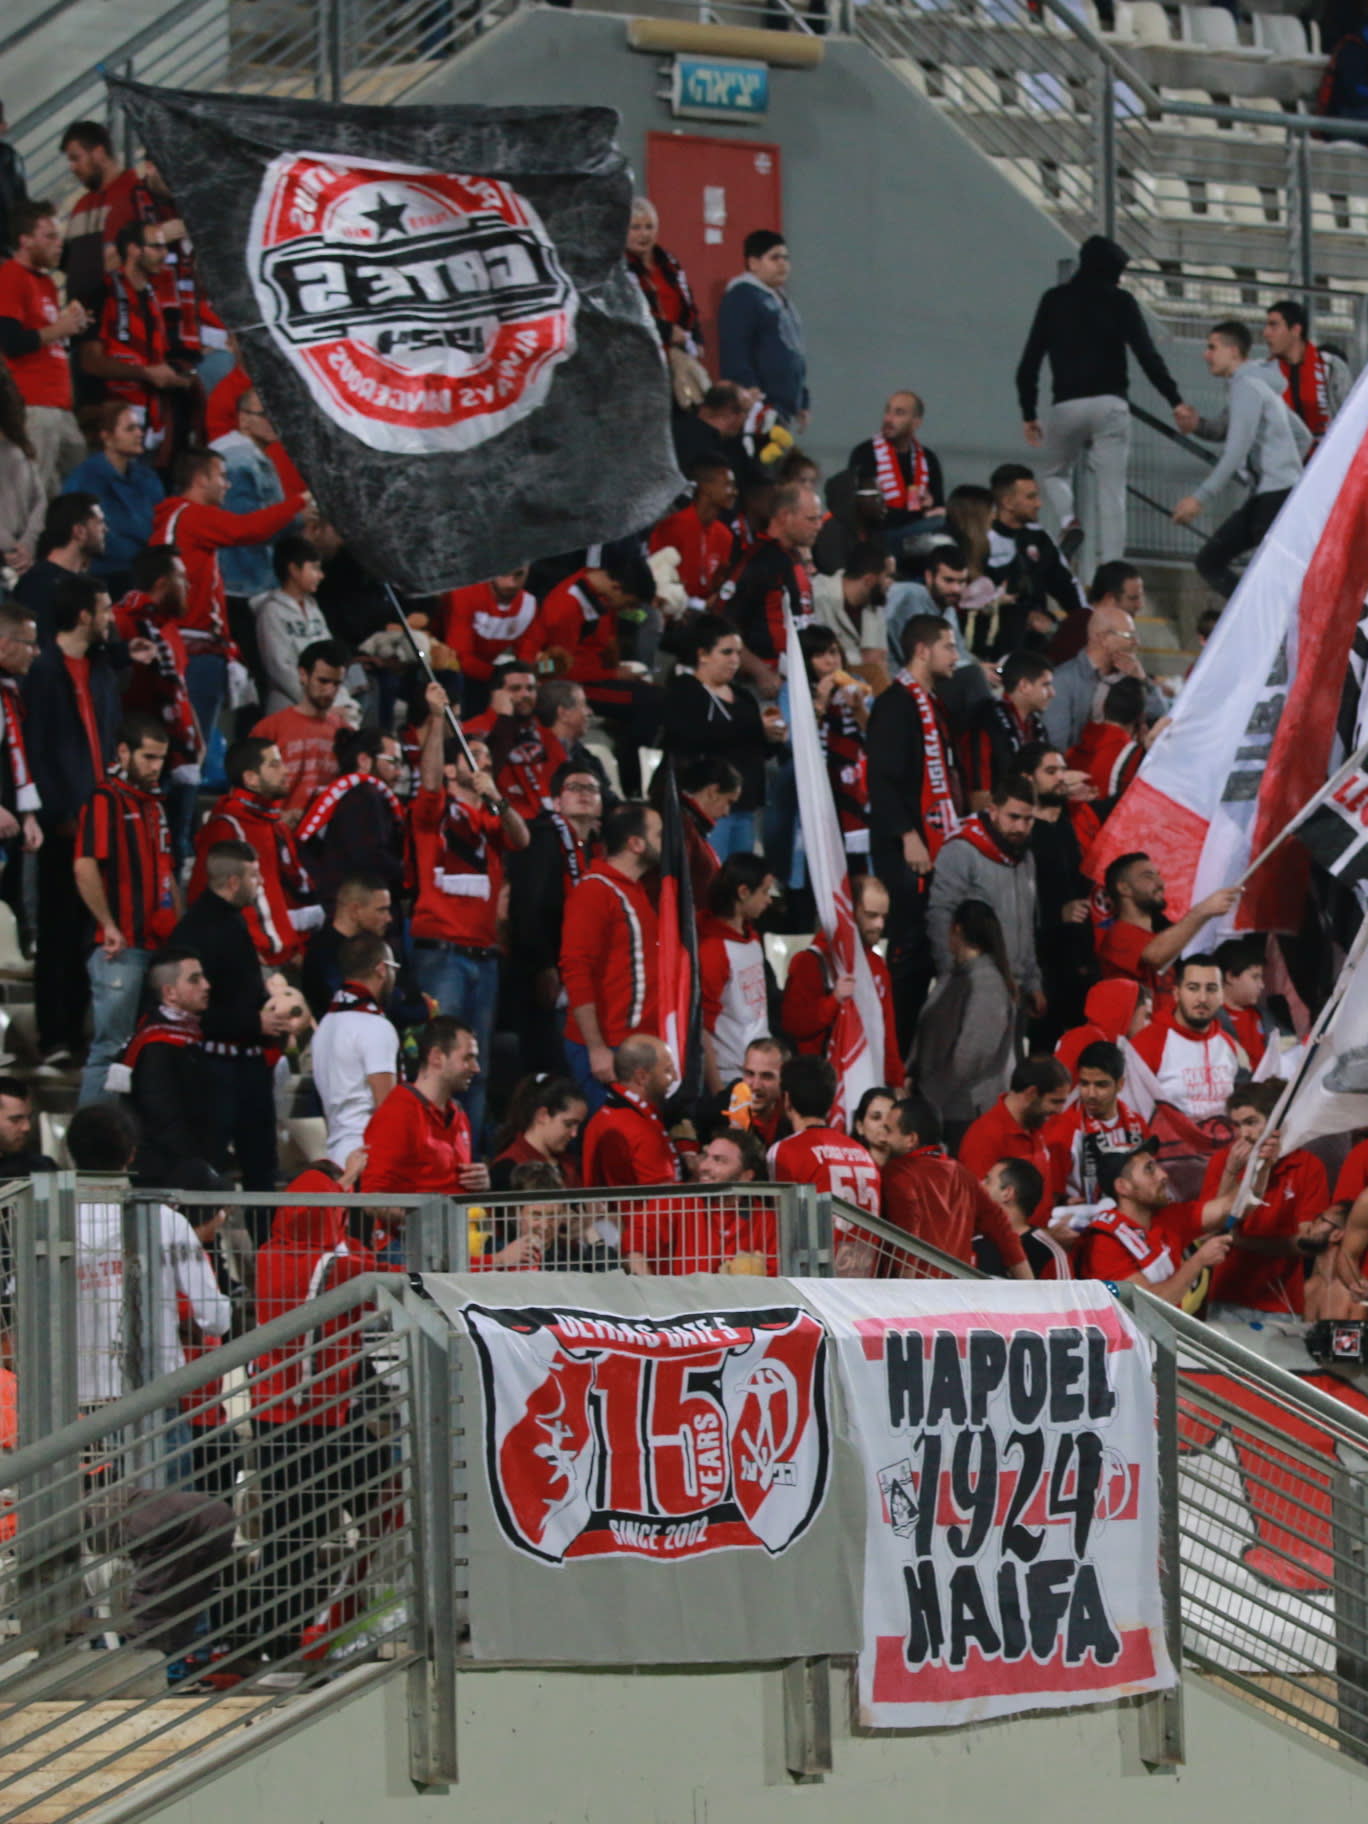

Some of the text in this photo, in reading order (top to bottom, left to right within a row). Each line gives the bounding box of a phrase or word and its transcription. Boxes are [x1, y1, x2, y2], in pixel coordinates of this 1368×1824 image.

[688, 69, 760, 107] יציאה
[556, 1313, 735, 1348] ULTRAS GATE 5
[886, 1326, 1116, 1428] HAPOEL
[592, 1351, 724, 1515] 15
[696, 1412, 722, 1505] YEARS
[609, 1519, 709, 1547] SINCE 2002
[913, 1426, 1103, 1562] 1924
[903, 1558, 1121, 1665] HAIFA
